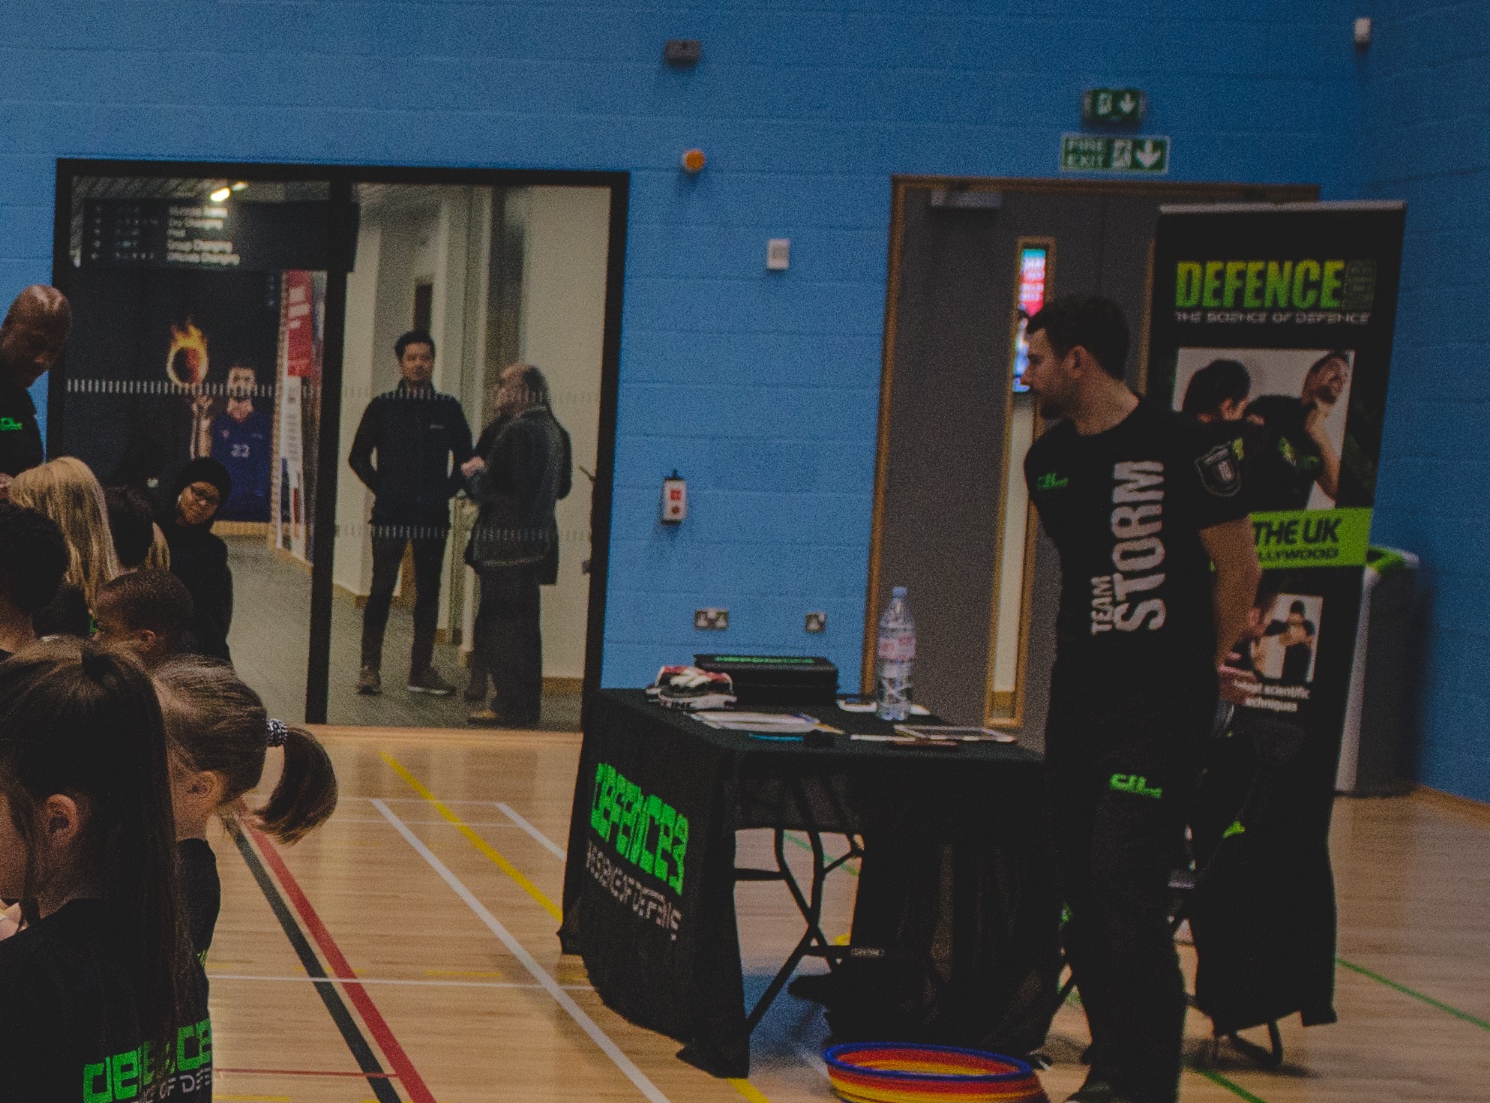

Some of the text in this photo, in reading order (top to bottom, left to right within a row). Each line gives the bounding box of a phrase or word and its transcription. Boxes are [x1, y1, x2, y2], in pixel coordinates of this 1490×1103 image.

[1174, 258, 1346, 310] DEFENCE
[1174, 311, 1372, 325] THE SCIENCE OF DEFENCE
[1111, 460, 1167, 632] STORM
[1253, 518, 1342, 545] THE UK
[1090, 575, 1114, 636] TEAM
